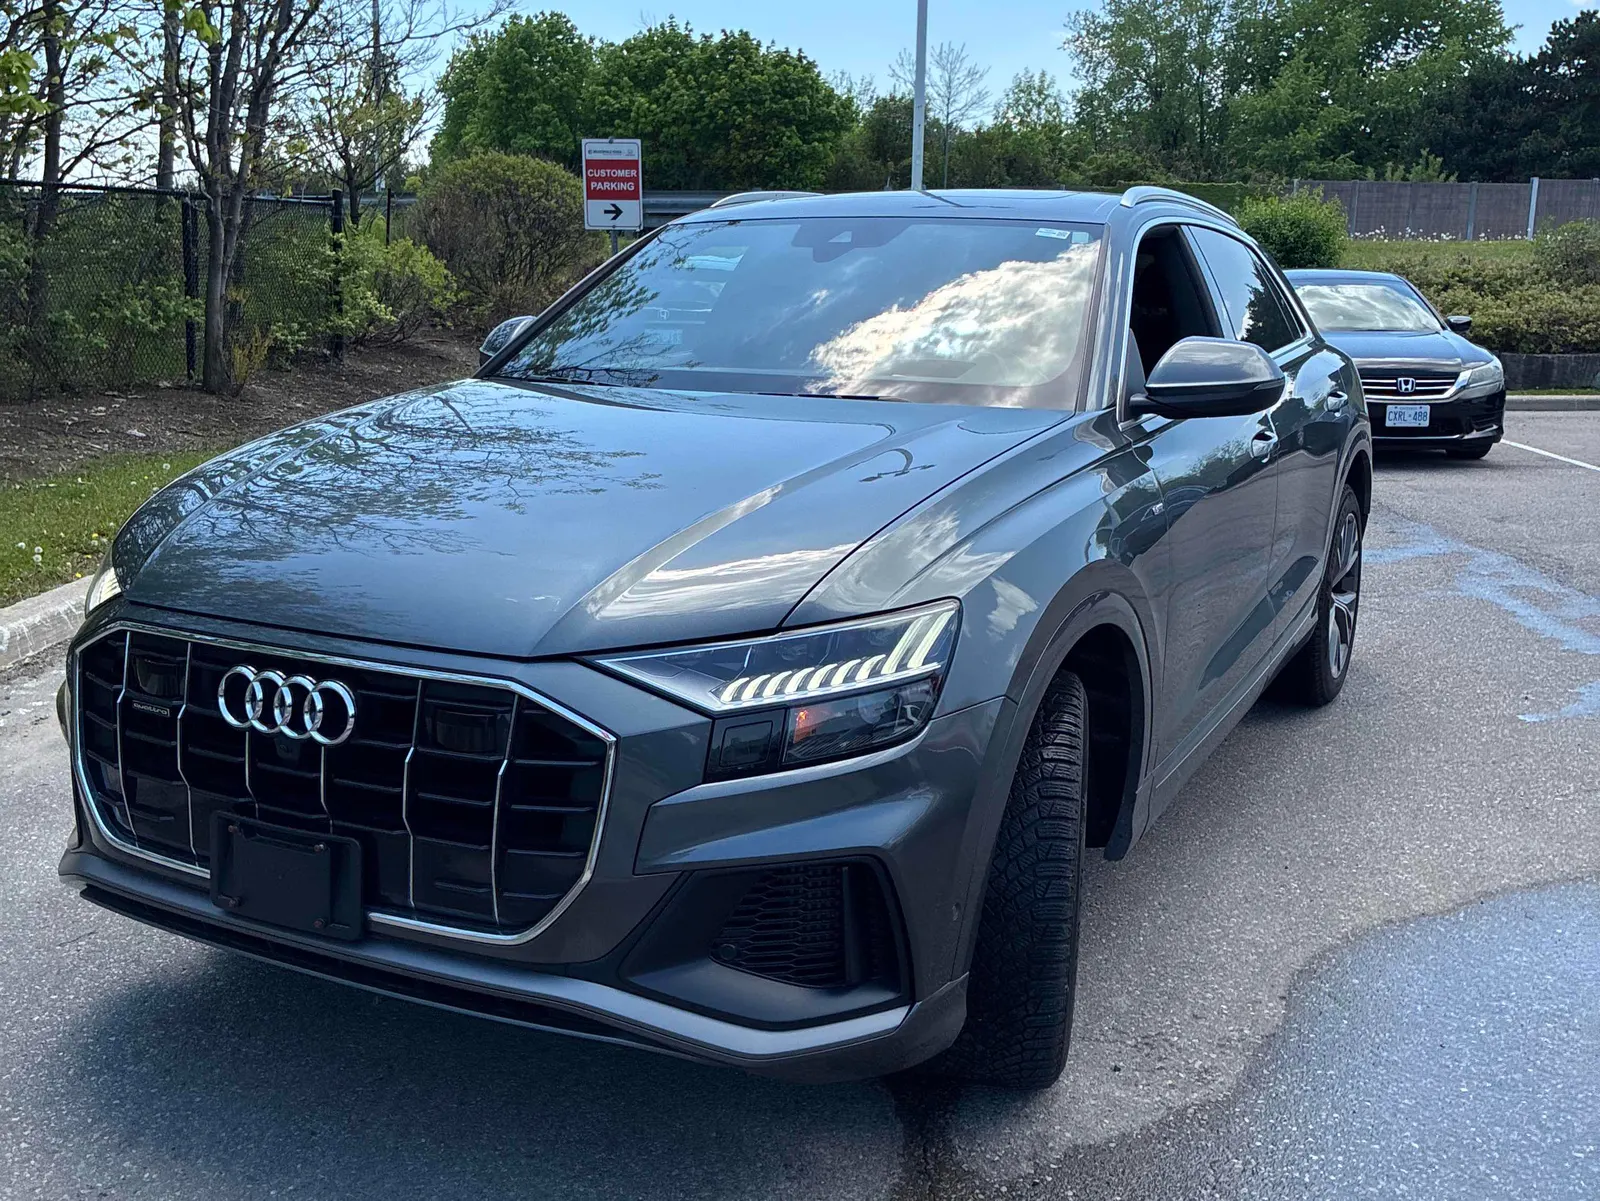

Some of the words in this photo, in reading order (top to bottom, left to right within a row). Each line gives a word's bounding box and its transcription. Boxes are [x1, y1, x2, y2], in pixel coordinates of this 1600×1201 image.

[587, 169, 638, 178] CUSTOMER
[590, 181, 635, 191] PARKING
[133, 702, 168, 715] quattro
